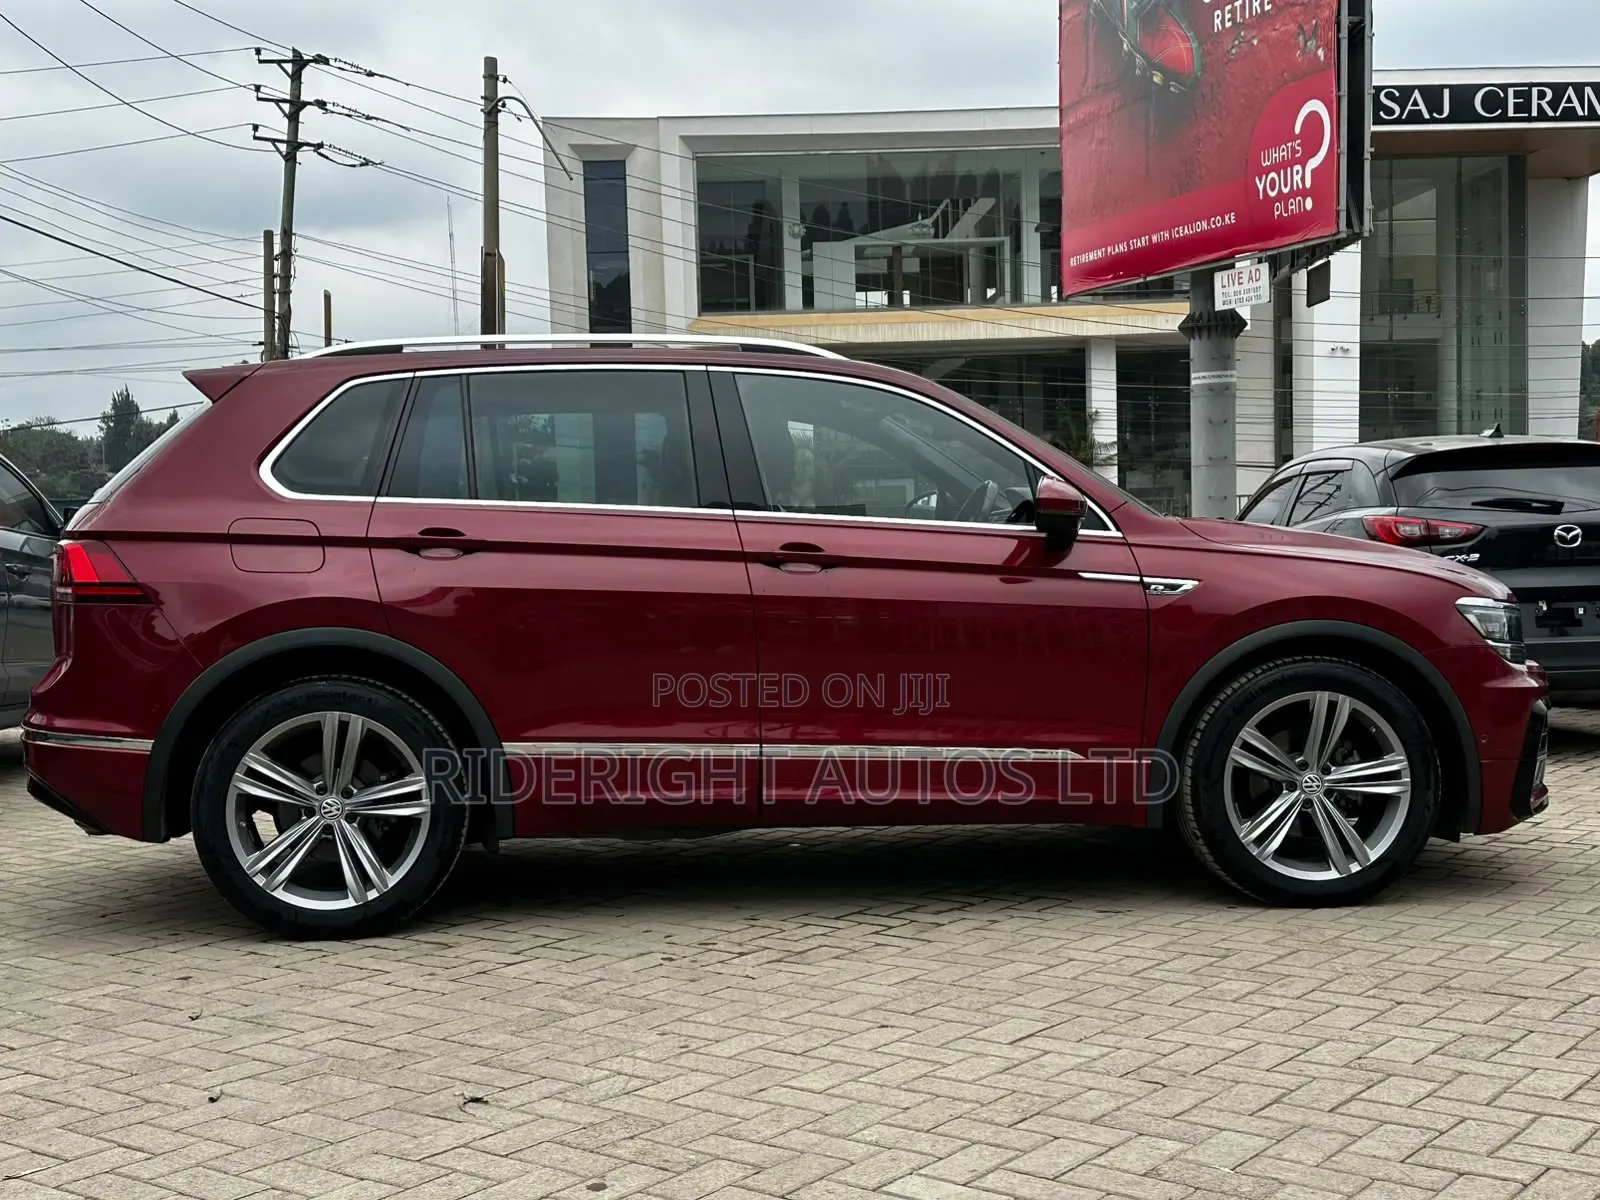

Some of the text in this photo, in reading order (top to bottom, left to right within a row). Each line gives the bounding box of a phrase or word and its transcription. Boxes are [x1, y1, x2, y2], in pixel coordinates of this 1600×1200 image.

[1213, 0, 1273, 33] RETIRE
[1378, 87, 1450, 120] SAJ
[1260, 139, 1302, 167] WHAT'S
[1070, 212, 1236, 266] RETIREMENT PLANS START WITH ICEALION.CO.KE
[1221, 268, 1261, 288] LIVE AD
